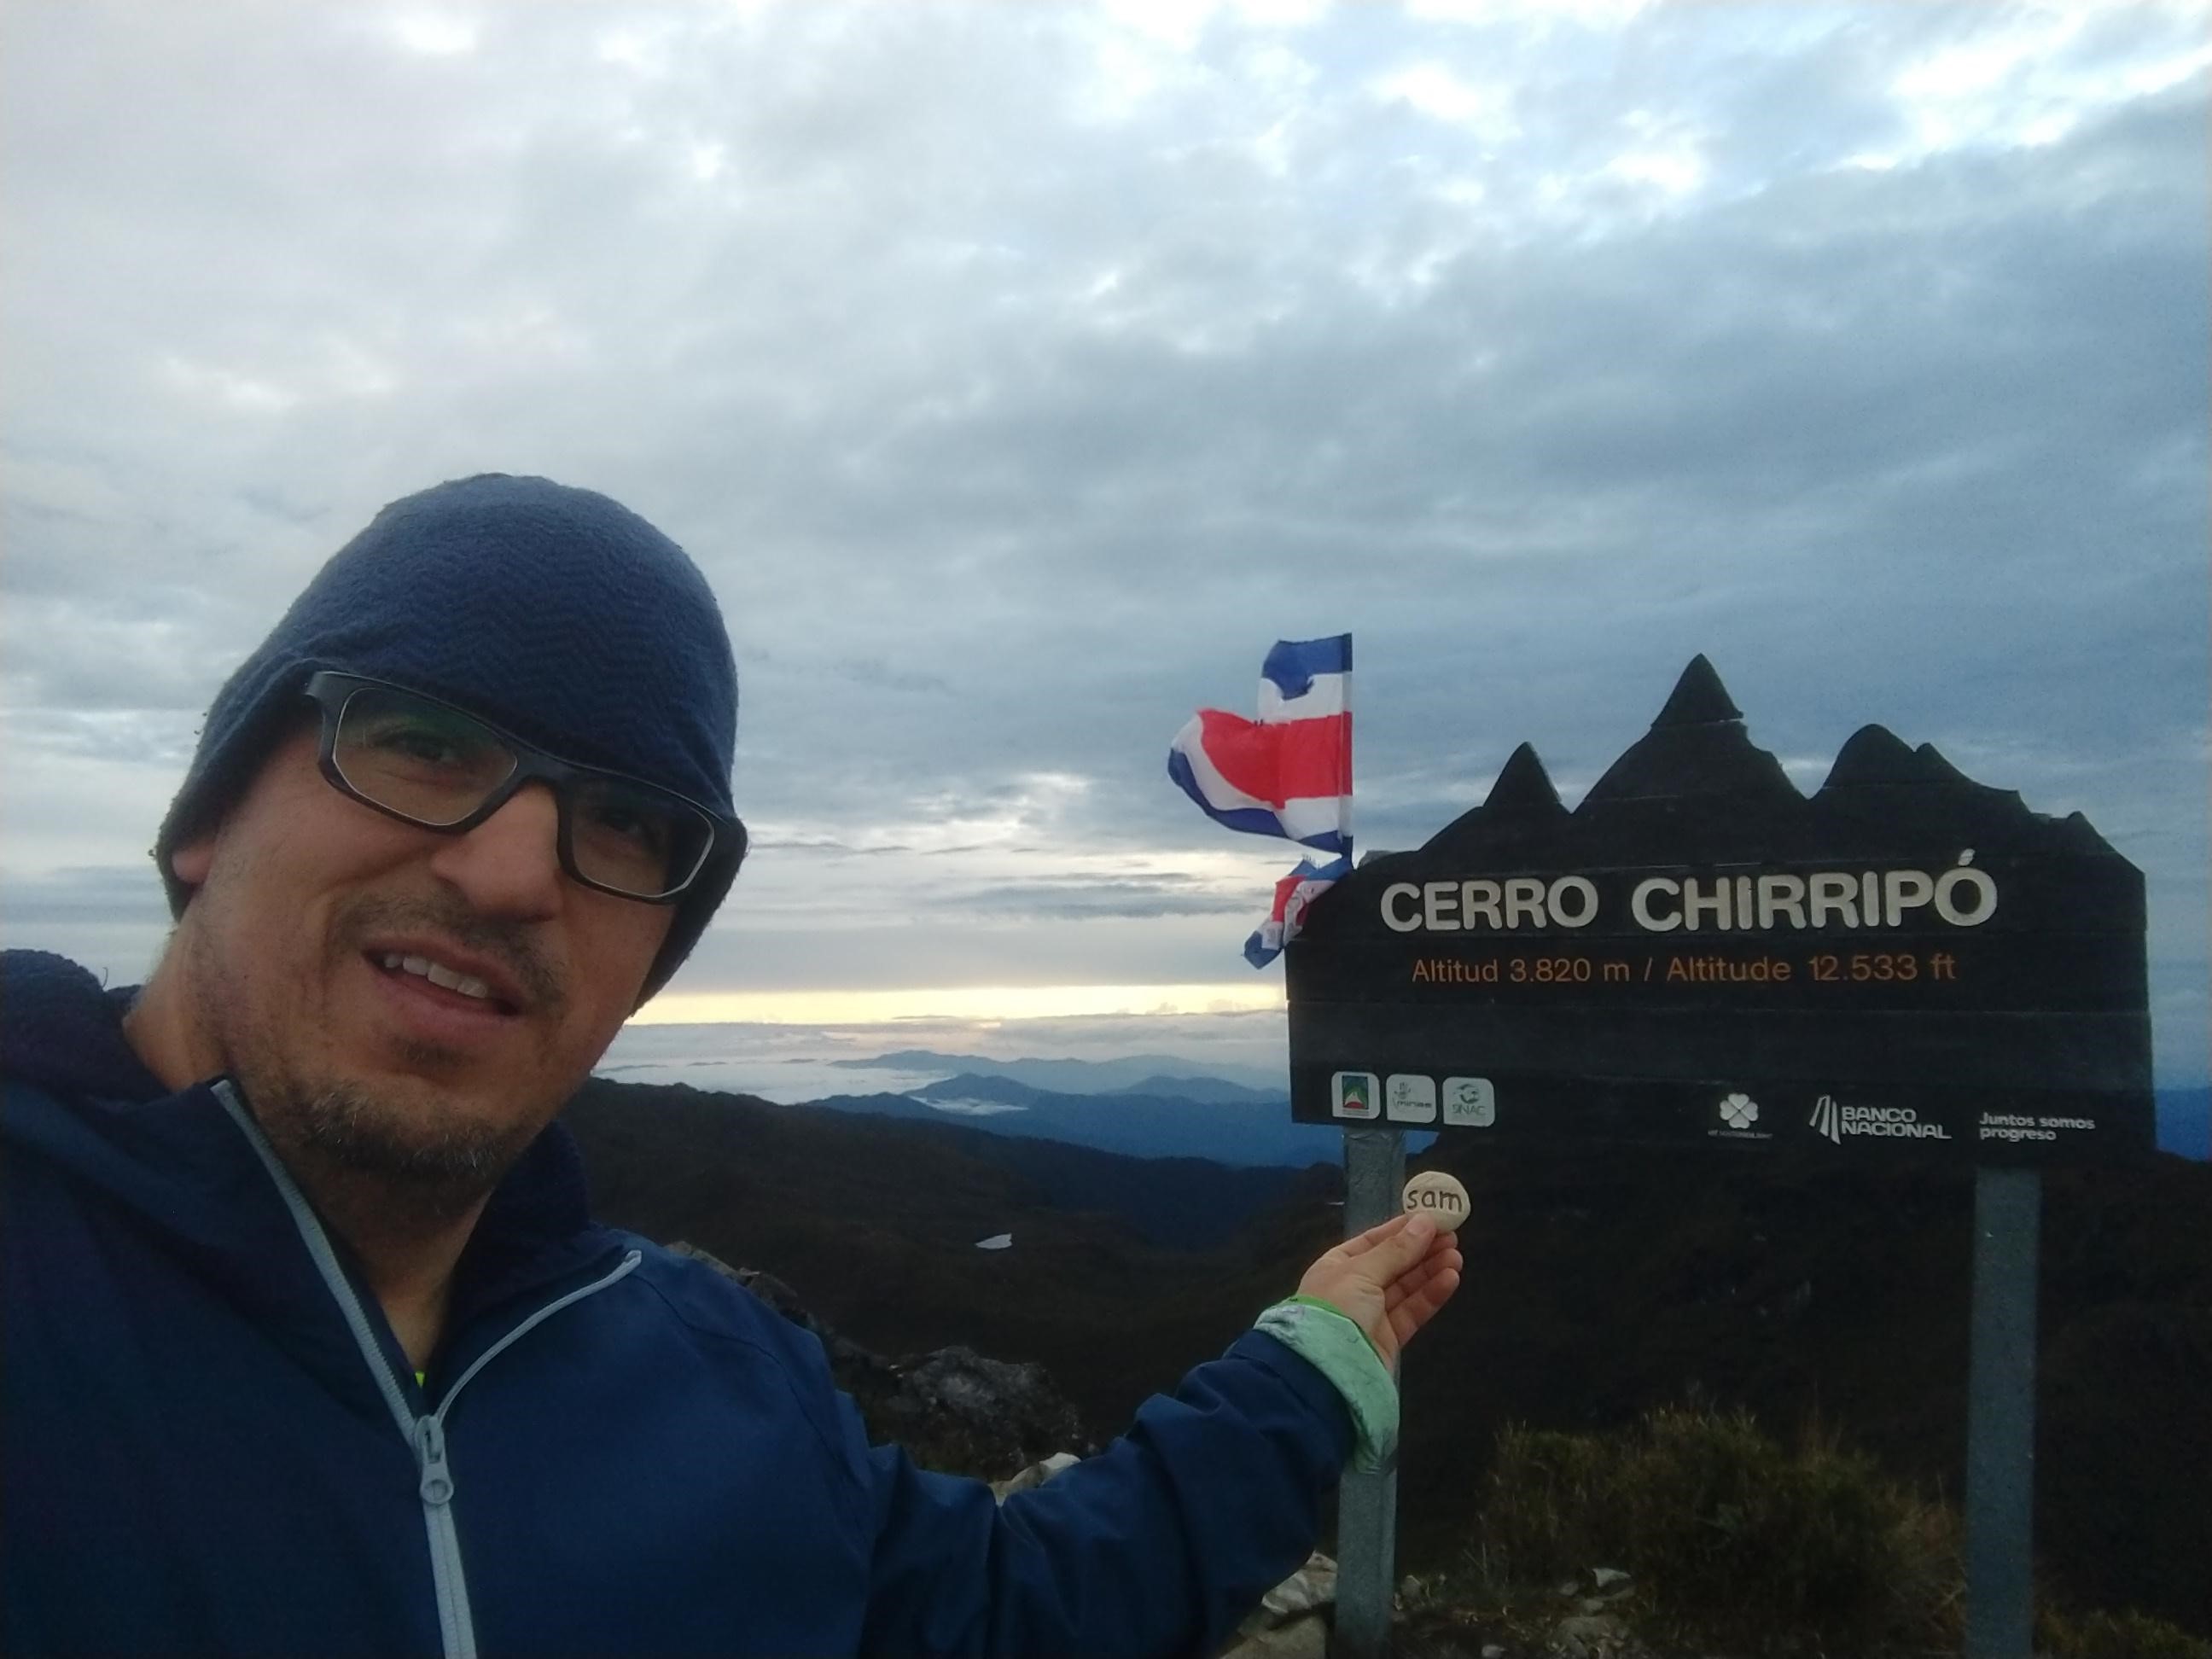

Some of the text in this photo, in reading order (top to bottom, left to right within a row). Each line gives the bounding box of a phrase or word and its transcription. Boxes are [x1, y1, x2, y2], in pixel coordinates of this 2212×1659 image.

[1380, 876, 1598, 932] CERRO
[1632, 848, 1998, 932] CHIRRIPÓ
[1412, 953, 1958, 982] Altitud 3.820 m / Altitude 12.533 ft
[1842, 1107, 1917, 1122] BANCO
[1980, 1112, 2096, 1129] Juntos somos
[1842, 1121, 1953, 1139] NACIONAL
[1980, 1127, 2057, 1143] progreso
[1407, 1190, 1462, 1212] sam
